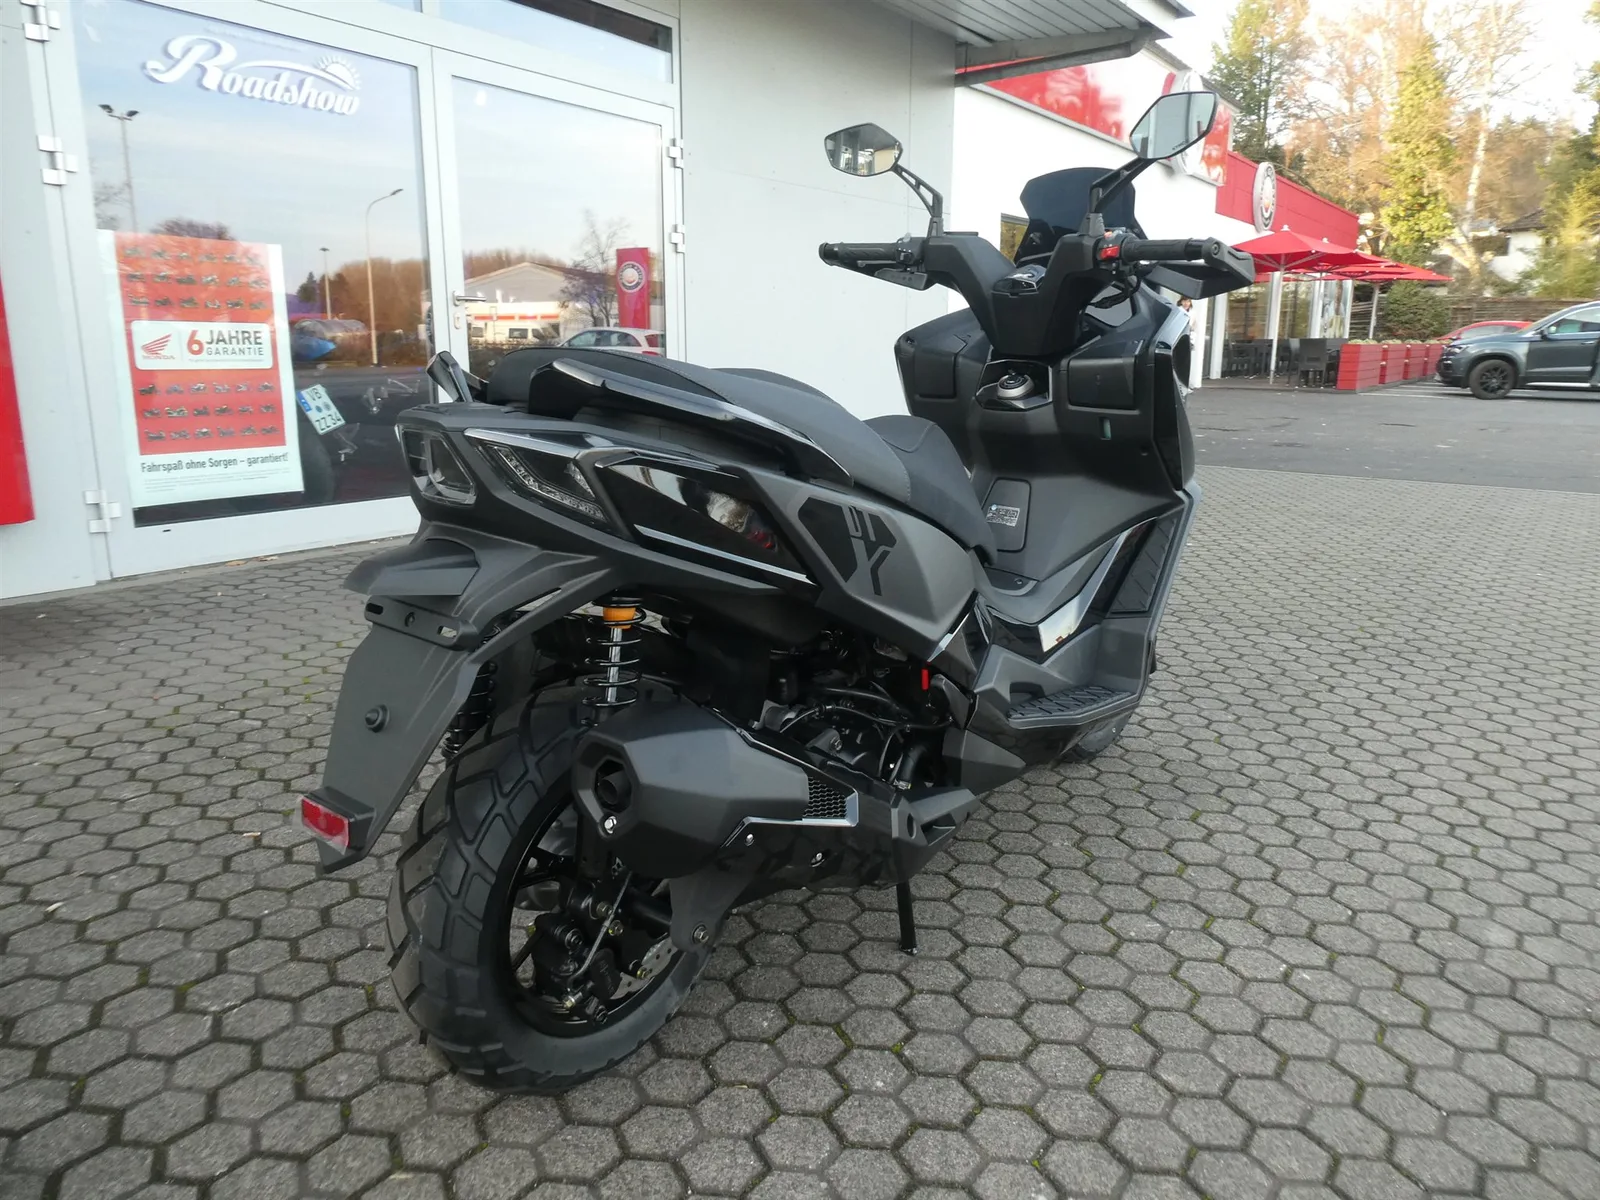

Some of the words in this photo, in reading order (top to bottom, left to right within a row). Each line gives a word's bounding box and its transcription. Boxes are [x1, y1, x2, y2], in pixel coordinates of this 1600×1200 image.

[143, 34, 360, 116] Roadshow
[187, 329, 204, 356] 6
[206, 329, 263, 346] JAHRE
[206, 347, 264, 356] GARANTIE
[141, 459, 184, 473] Fahrspaß
[186, 460, 207, 469] ohne
[208, 457, 238, 469] Sorgen
[247, 452, 289, 467] garantiert!
